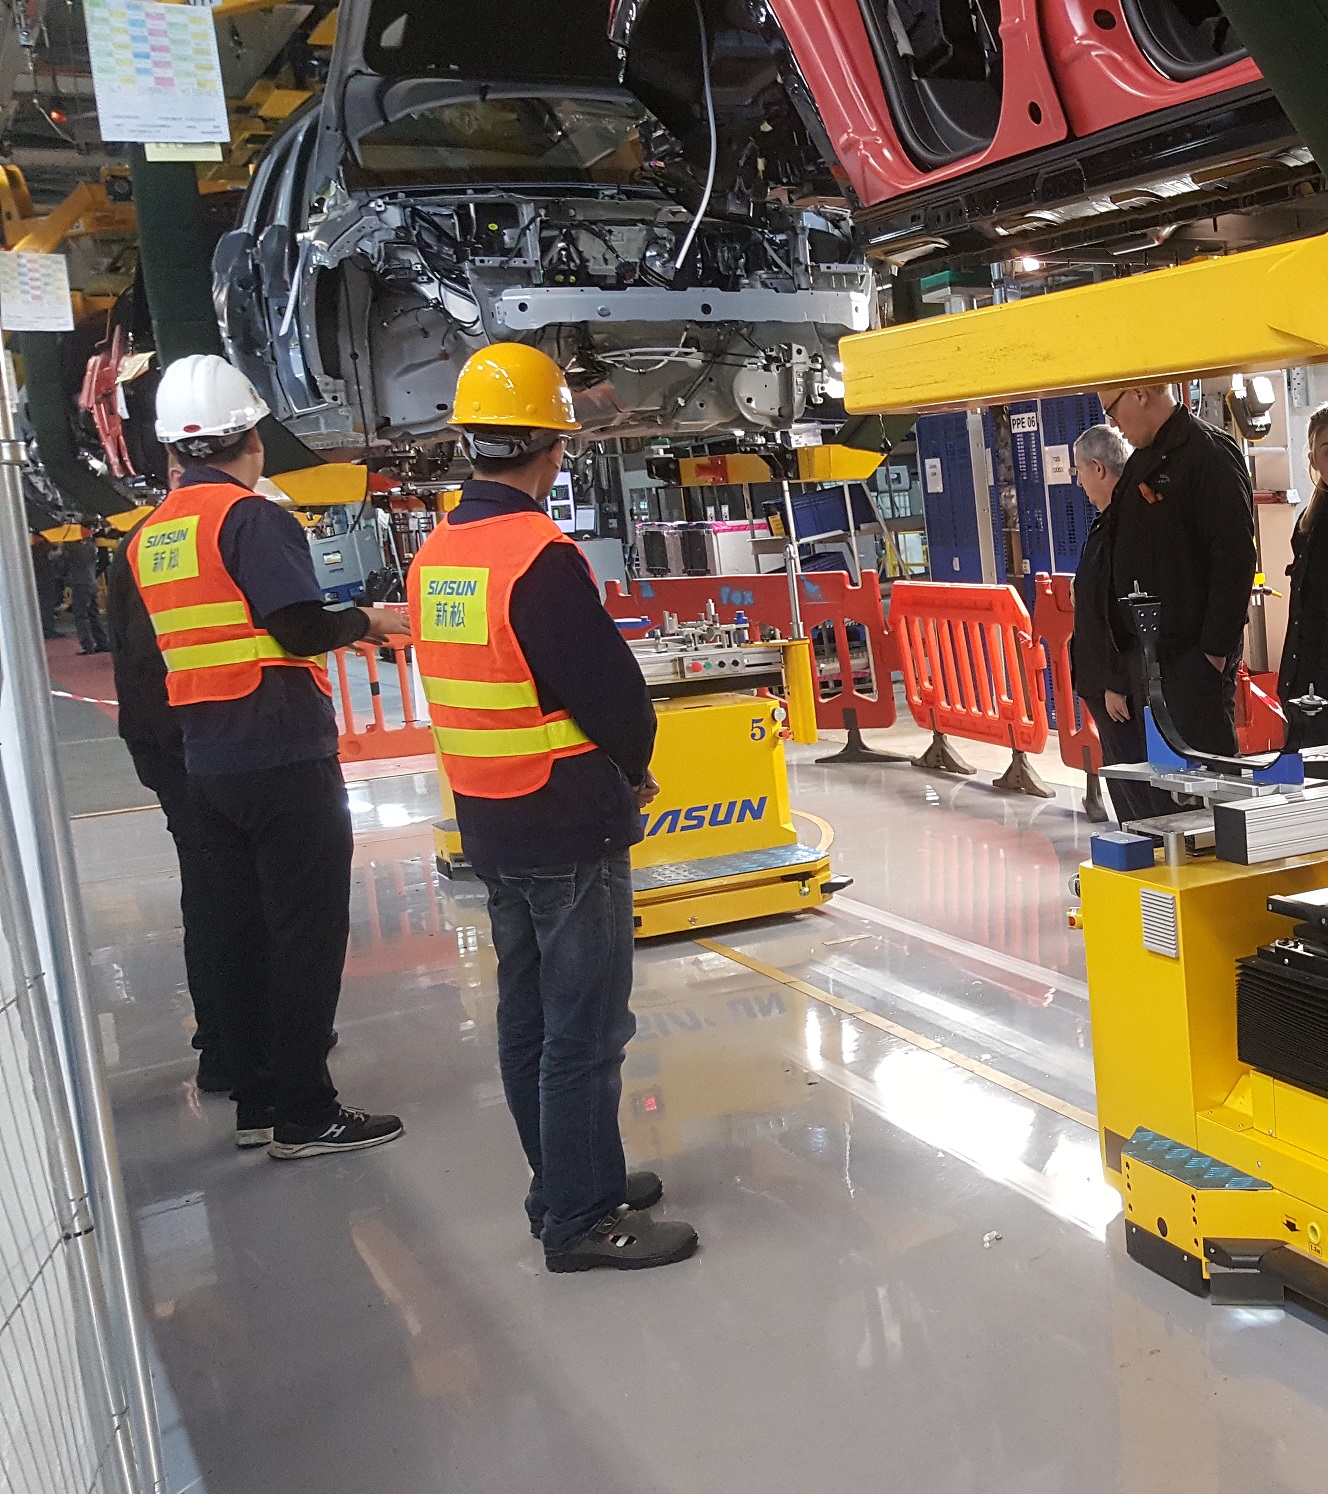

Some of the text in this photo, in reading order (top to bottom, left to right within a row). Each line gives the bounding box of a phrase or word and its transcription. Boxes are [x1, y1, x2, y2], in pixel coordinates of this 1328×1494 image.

[1012, 416, 1036, 430] PPE 06
[145, 528, 189, 549] SIASUN
[427, 580, 478, 596] SIASUN
[435, 601, 466, 628] 新松
[750, 717, 766, 741] 5
[640, 796, 768, 838] ASUN
